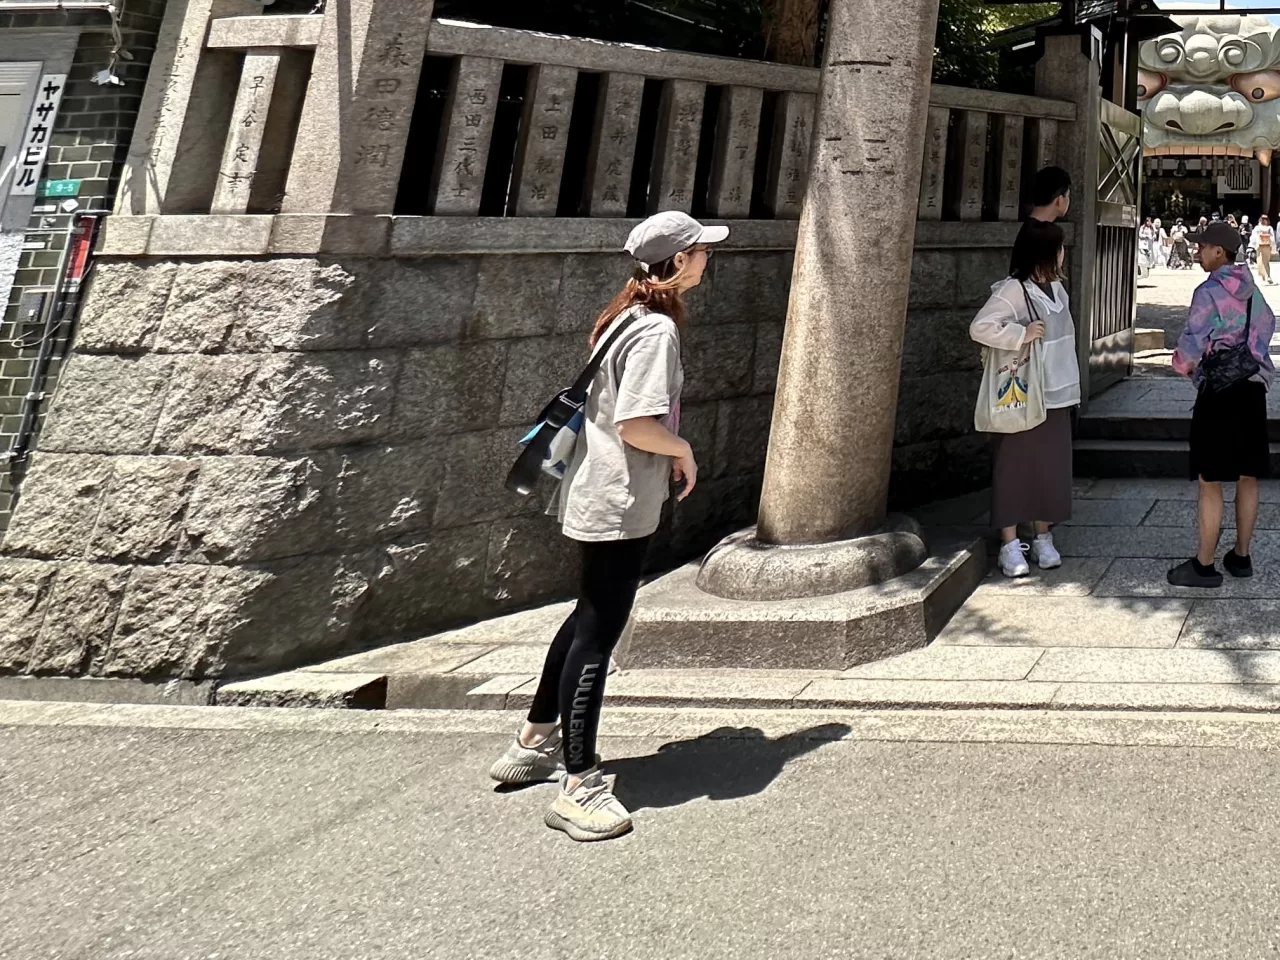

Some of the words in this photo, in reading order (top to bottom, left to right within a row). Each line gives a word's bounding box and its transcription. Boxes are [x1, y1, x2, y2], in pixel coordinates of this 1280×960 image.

[17, 81, 60, 187] ヤサカビル
[56, 183, 74, 193] 9-5
[569, 663, 600, 765] LULULEMON
